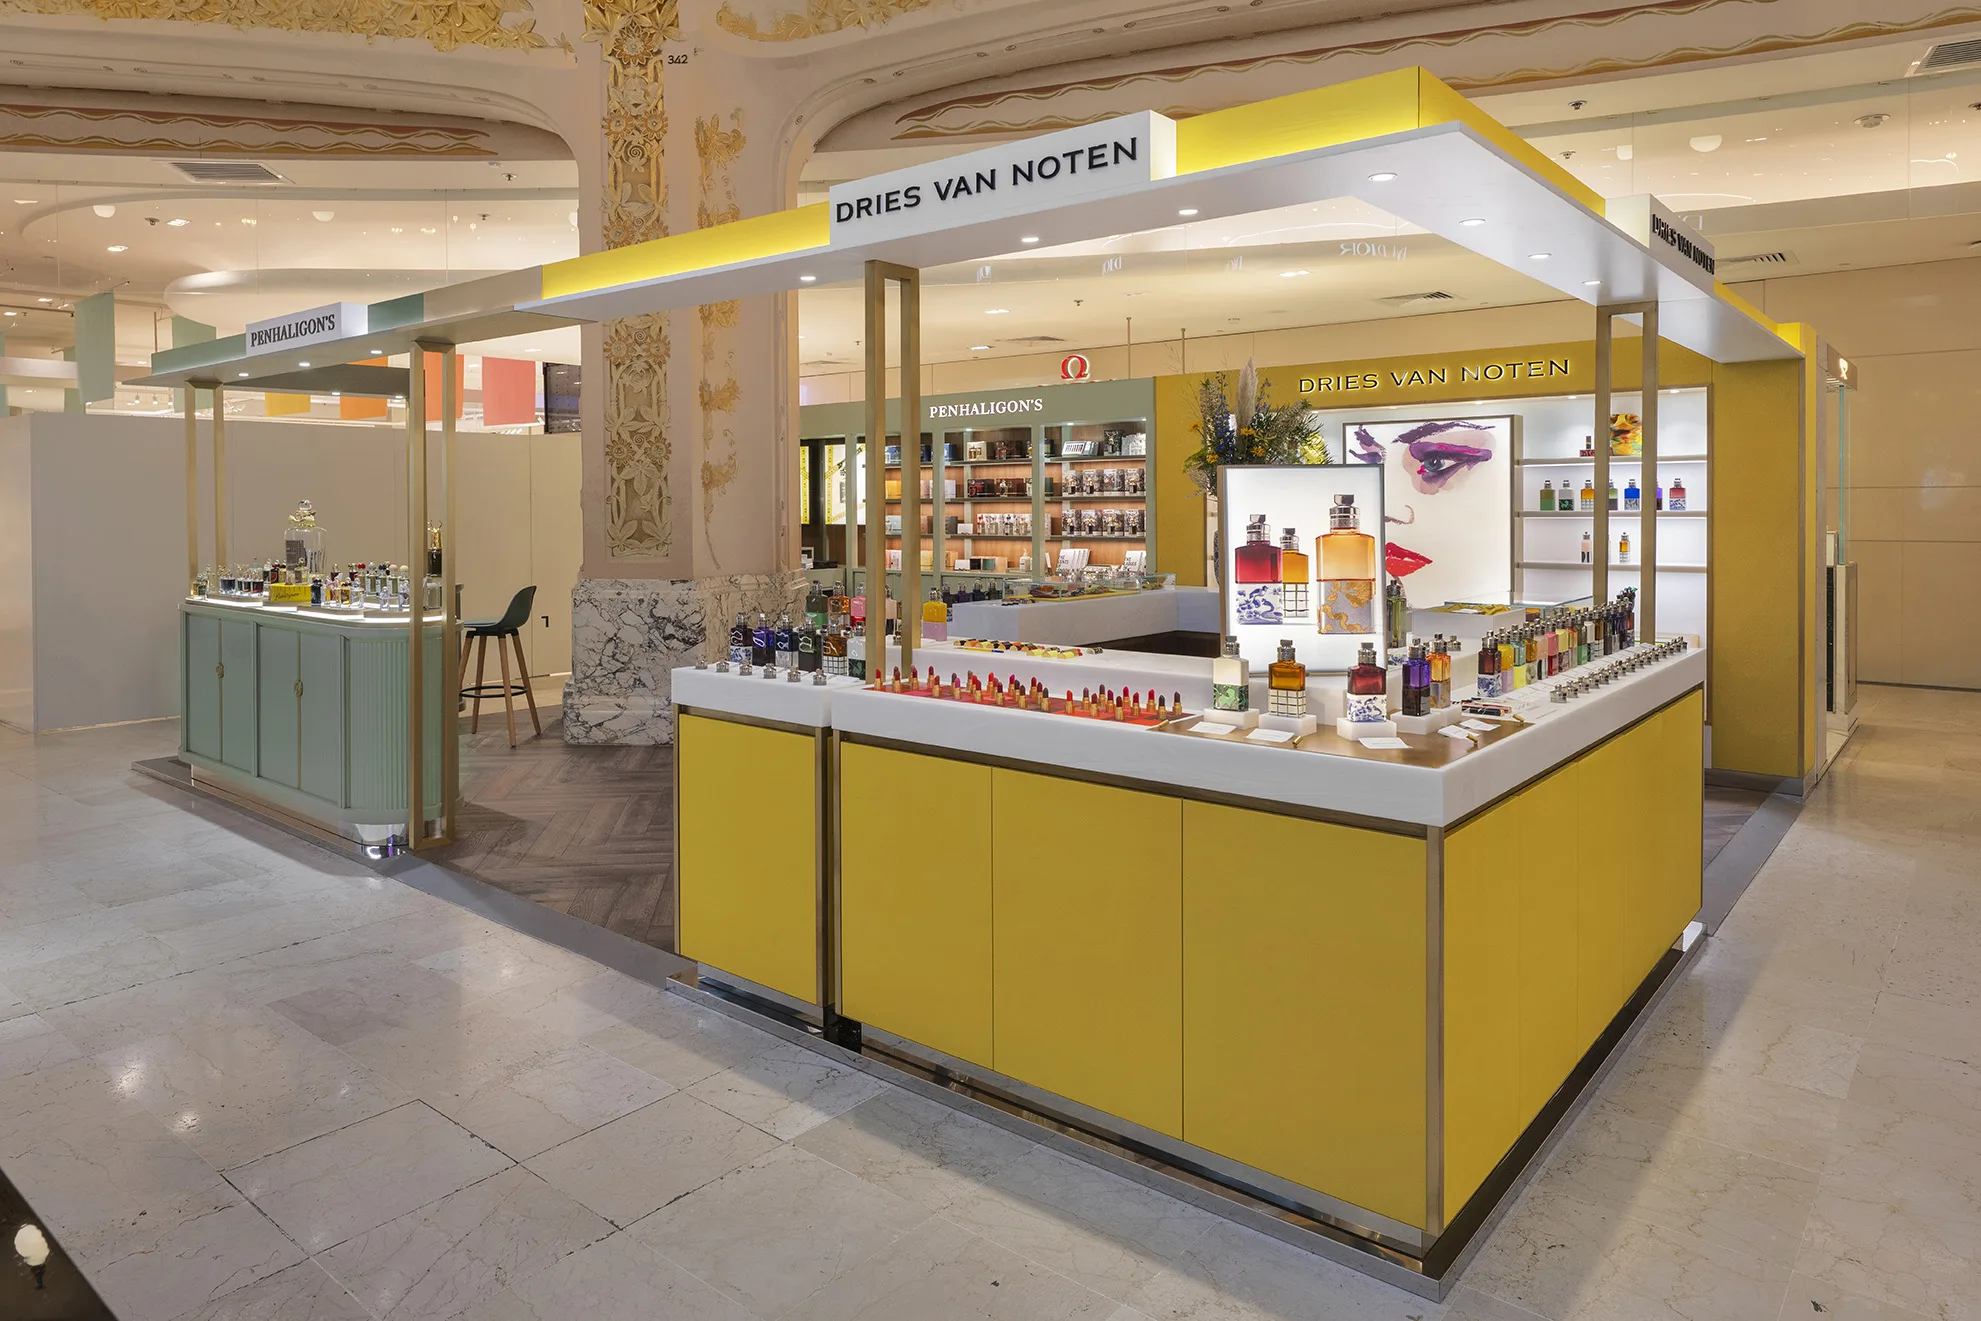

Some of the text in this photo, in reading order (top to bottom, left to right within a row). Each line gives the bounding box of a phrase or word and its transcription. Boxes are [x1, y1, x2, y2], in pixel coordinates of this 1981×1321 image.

[667, 54, 688, 65] 342
[836, 137, 1137, 223] DRIES VAN NOTEN
[1652, 213, 1676, 246] DRIES
[1677, 233, 1692, 259] VAN
[250, 313, 335, 347] PENHALIGON'S
[1299, 358, 1570, 393] DRIES VAN NOTEN
[929, 398, 1043, 419] PENHALIGON'S
